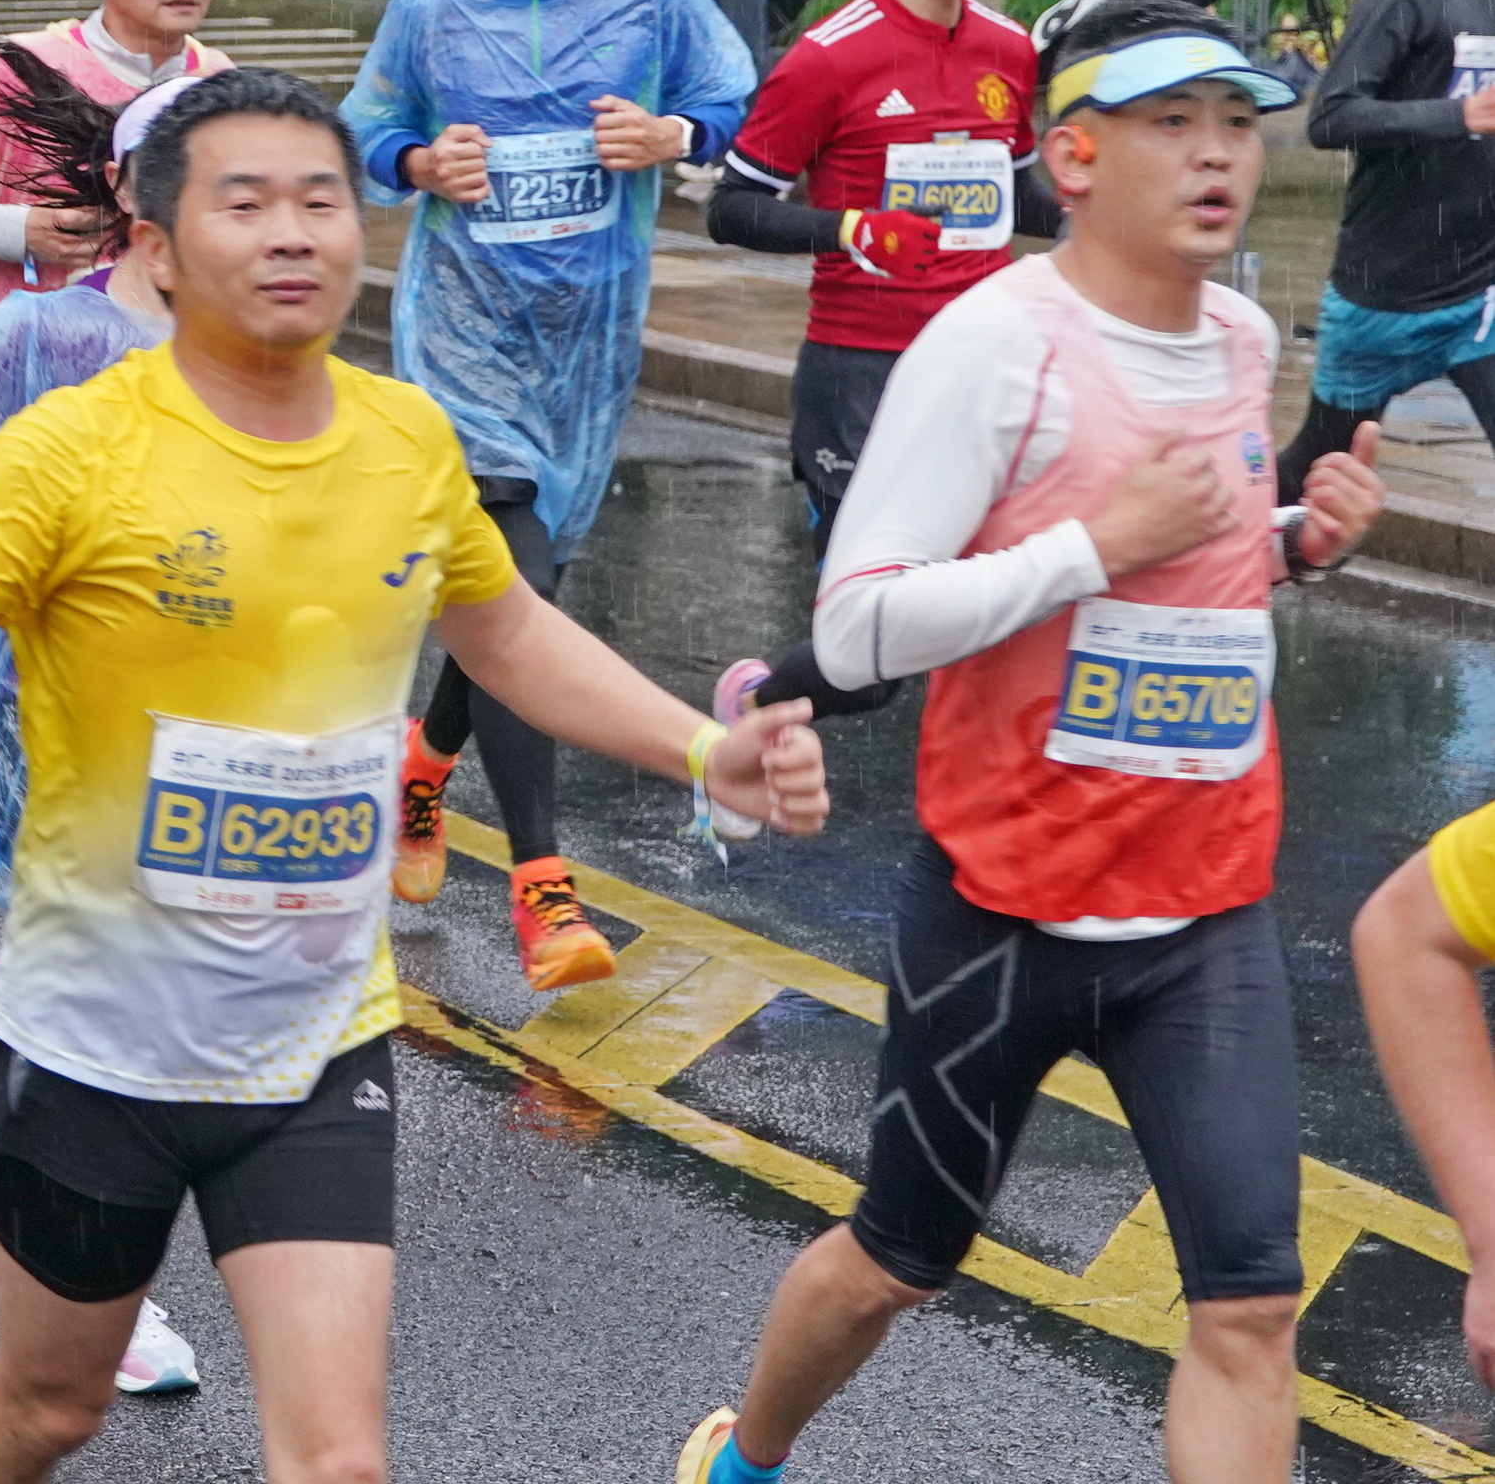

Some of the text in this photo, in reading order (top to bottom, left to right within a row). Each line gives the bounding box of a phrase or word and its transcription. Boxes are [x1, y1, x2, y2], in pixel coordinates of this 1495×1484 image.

[510, 168, 603, 206] 22571
[1065, 661, 1259, 725] B 65709
[149, 790, 374, 859] B 62933
